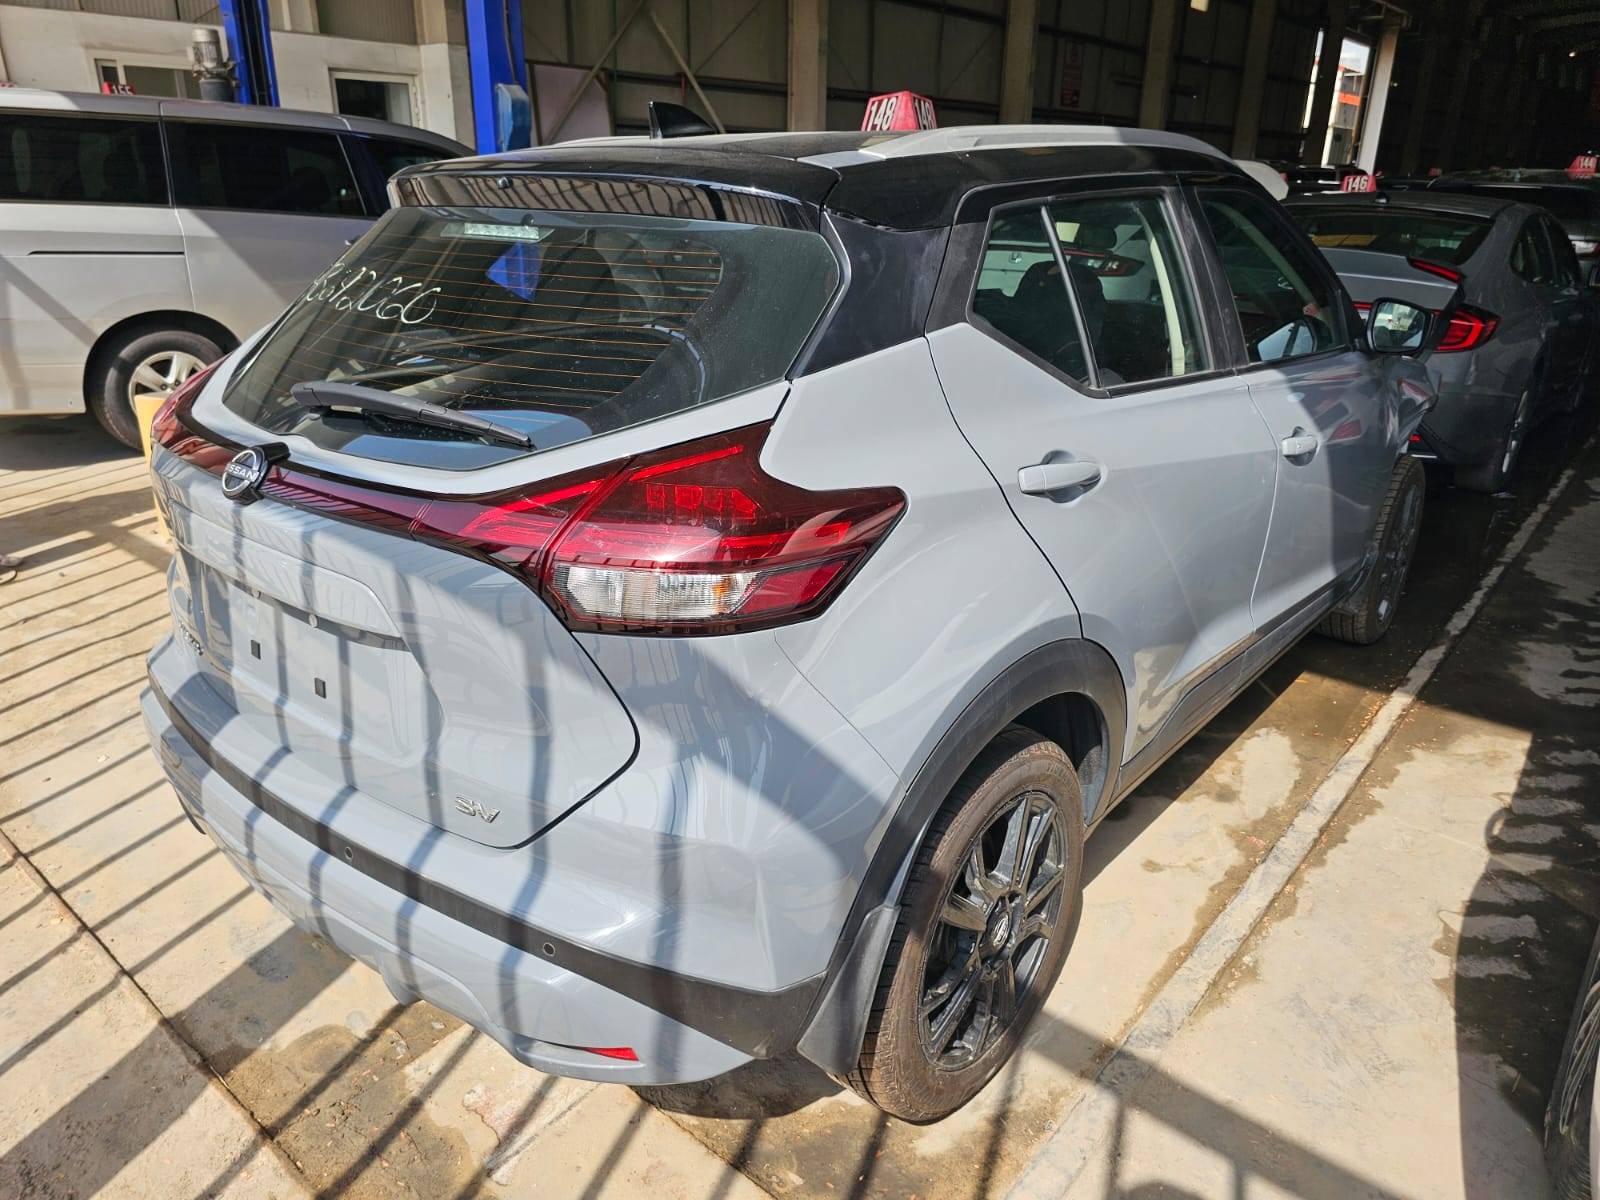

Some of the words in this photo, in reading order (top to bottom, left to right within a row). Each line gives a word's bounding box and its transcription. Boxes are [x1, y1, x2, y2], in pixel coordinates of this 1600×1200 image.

[866, 96, 897, 132] 148
[1347, 175, 1368, 192] 146
[223, 461, 260, 482] SSAN
[455, 797, 500, 823] SV
